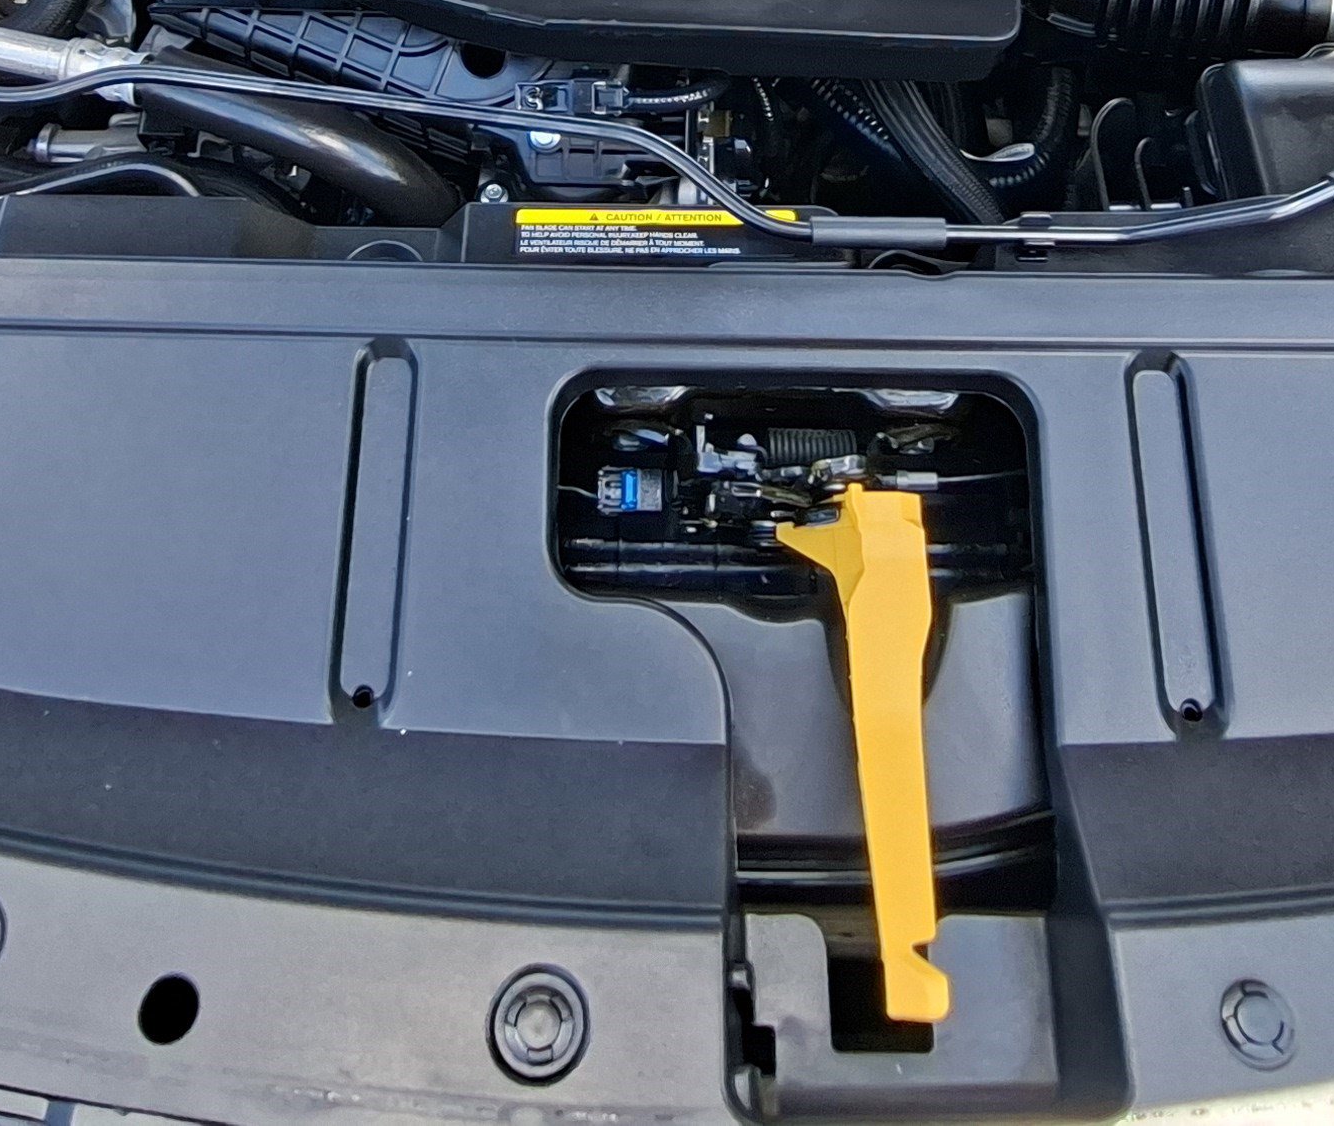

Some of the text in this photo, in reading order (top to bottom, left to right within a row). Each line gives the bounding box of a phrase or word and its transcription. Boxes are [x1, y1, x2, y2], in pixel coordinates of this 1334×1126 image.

[605, 212, 653, 222] CAUTION
[664, 213, 723, 223] ATTENTION
[549, 231, 571, 239] AVOID
